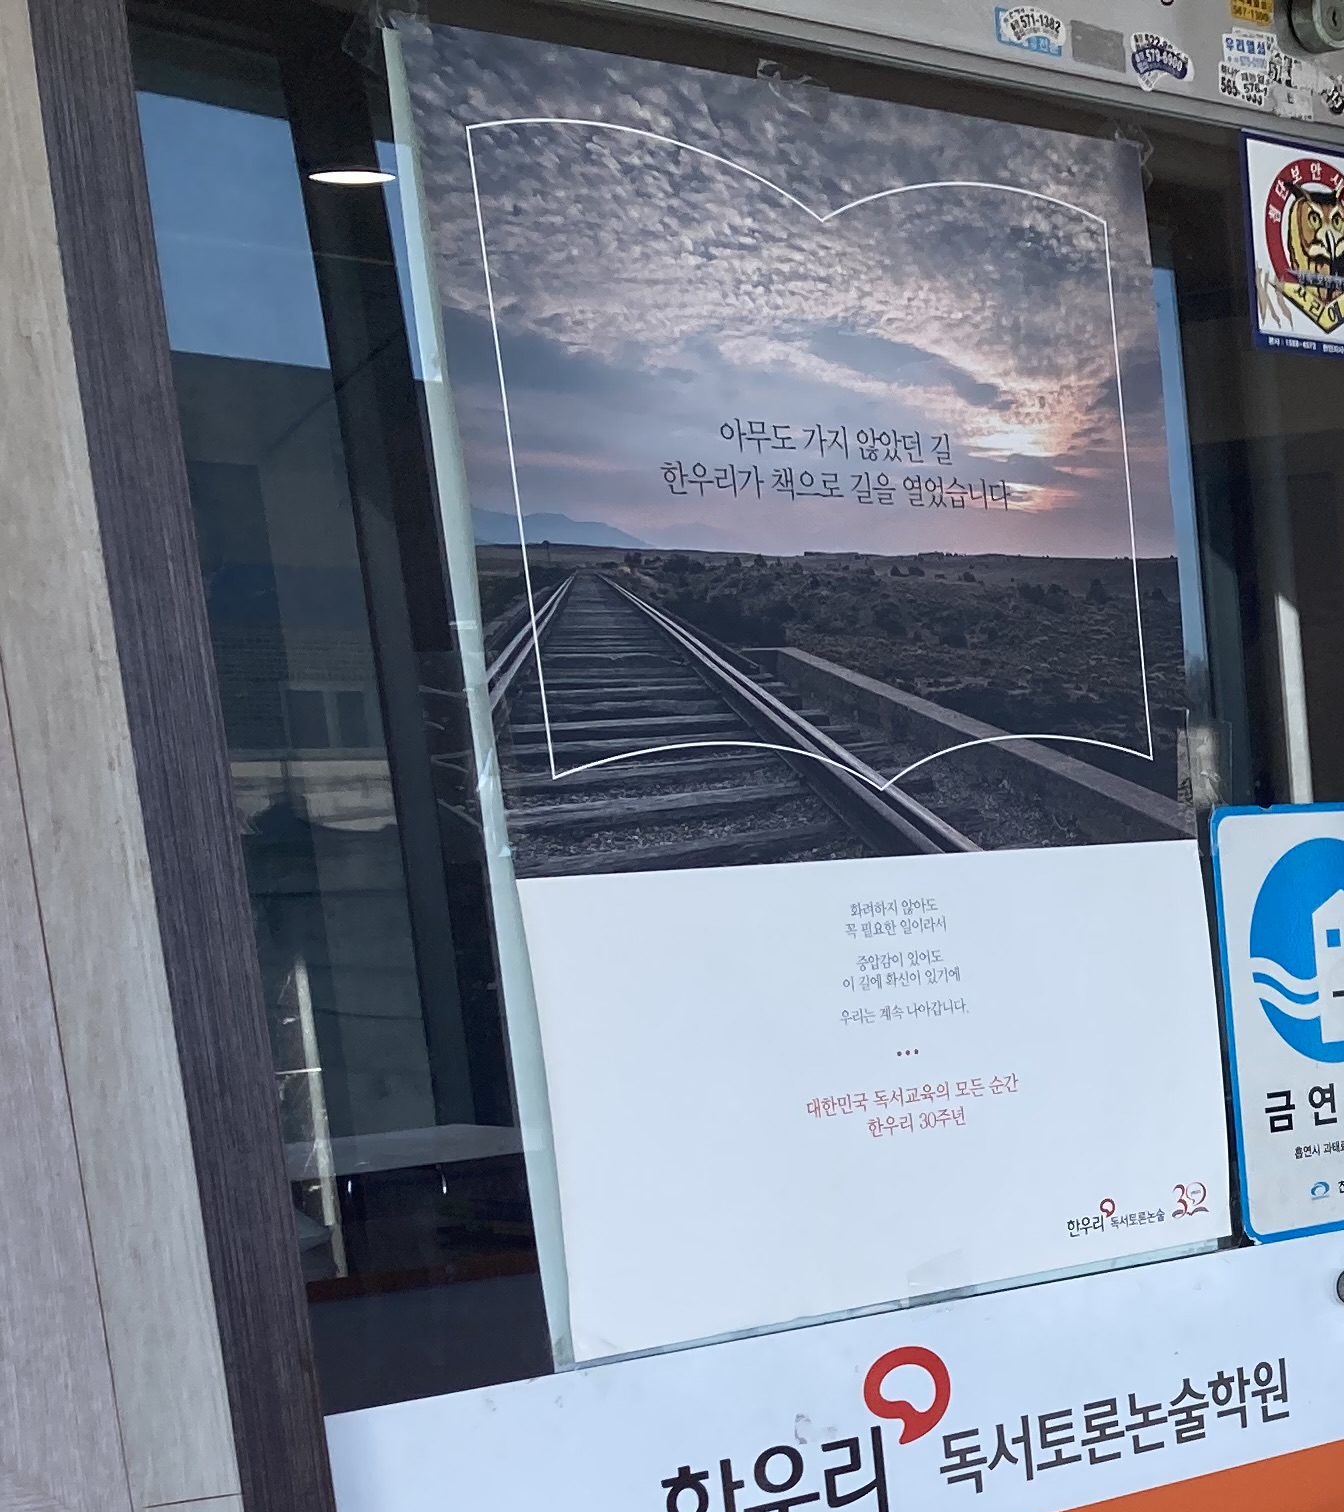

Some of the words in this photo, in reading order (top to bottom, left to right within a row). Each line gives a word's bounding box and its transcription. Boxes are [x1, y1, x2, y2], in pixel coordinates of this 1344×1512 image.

[720, 418, 797, 454] 아무도
[802, 423, 850, 460] 가지
[857, 427, 923, 464] 않았던
[930, 433, 953, 466] 길
[660, 460, 764, 500] 한우리가
[772, 467, 845, 501] 책으로
[851, 470, 896, 506] 길을
[850, 899, 898, 919] 화려하지
[902, 897, 939, 915] 않아도
[845, 923, 858, 939] 꼭
[861, 920, 897, 938] 필요한
[900, 915, 947, 935] 일이라서
[856, 951, 904, 972] 중압감이
[907, 949, 944, 967] 있어도
[842, 975, 855, 992] 이
[858, 972, 882, 991] 길에
[924, 966, 962, 985] 있기에
[840, 1006, 877, 1026] 우리는
[880, 1003, 904, 1021] 계속
[906, 997, 970, 1020] 나아갑니다.
[806, 1092, 869, 1119] 대한민국
[873, 1080, 950, 1110] 독서교육의
[955, 1077, 985, 1098] 모든
[988, 1072, 1020, 1095] 순간
[866, 1112, 915, 1138] 한우리
[919, 1105, 967, 1130] 30주년
[1294, 1143, 1321, 1160] 흡연시
[1066, 1214, 1105, 1238] 한우리
[1110, 1207, 1166, 1230] 독서토론논술
[939, 1357, 1290, 1494] 독서토론논술학원
